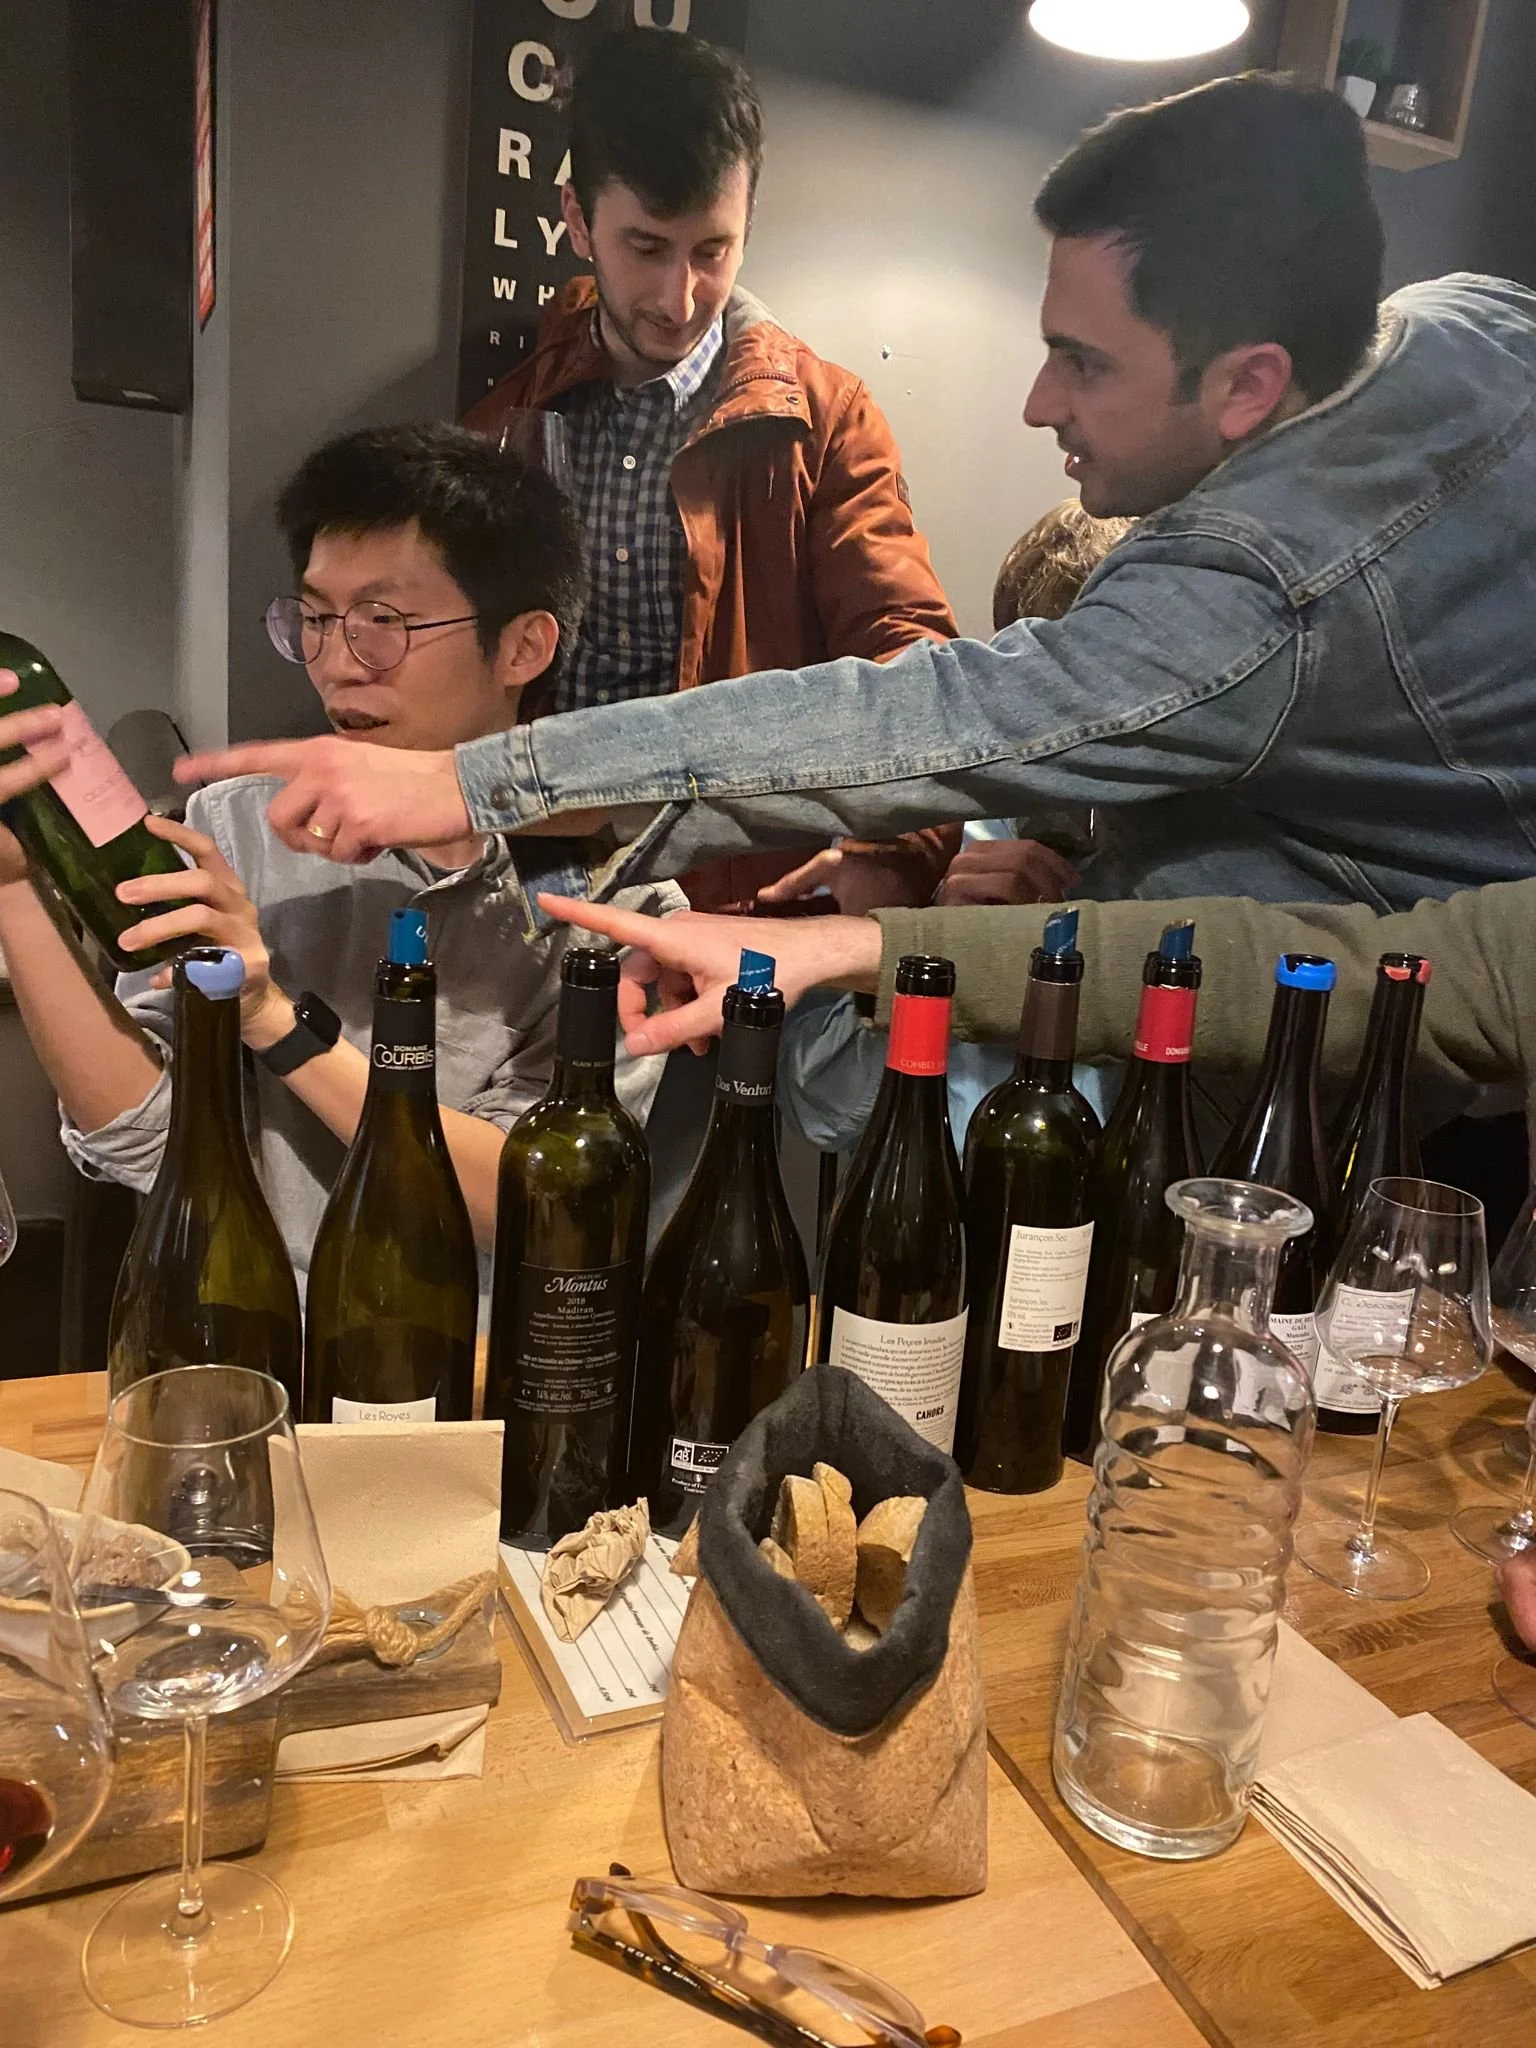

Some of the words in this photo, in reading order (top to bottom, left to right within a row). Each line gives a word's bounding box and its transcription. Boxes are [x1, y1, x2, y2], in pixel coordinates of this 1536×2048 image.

[373, 1043, 434, 1068] COURBIS
[1016, 1230, 1053, 1243] Jurançon
[544, 1277, 608, 1294] Montus
[557, 1305, 594, 1314] Madiran
[880, 1335, 895, 1345] Les
[359, 1410, 376, 1421] Les
[380, 1410, 411, 1422] Royes
[916, 1405, 945, 1421] CAHORS
